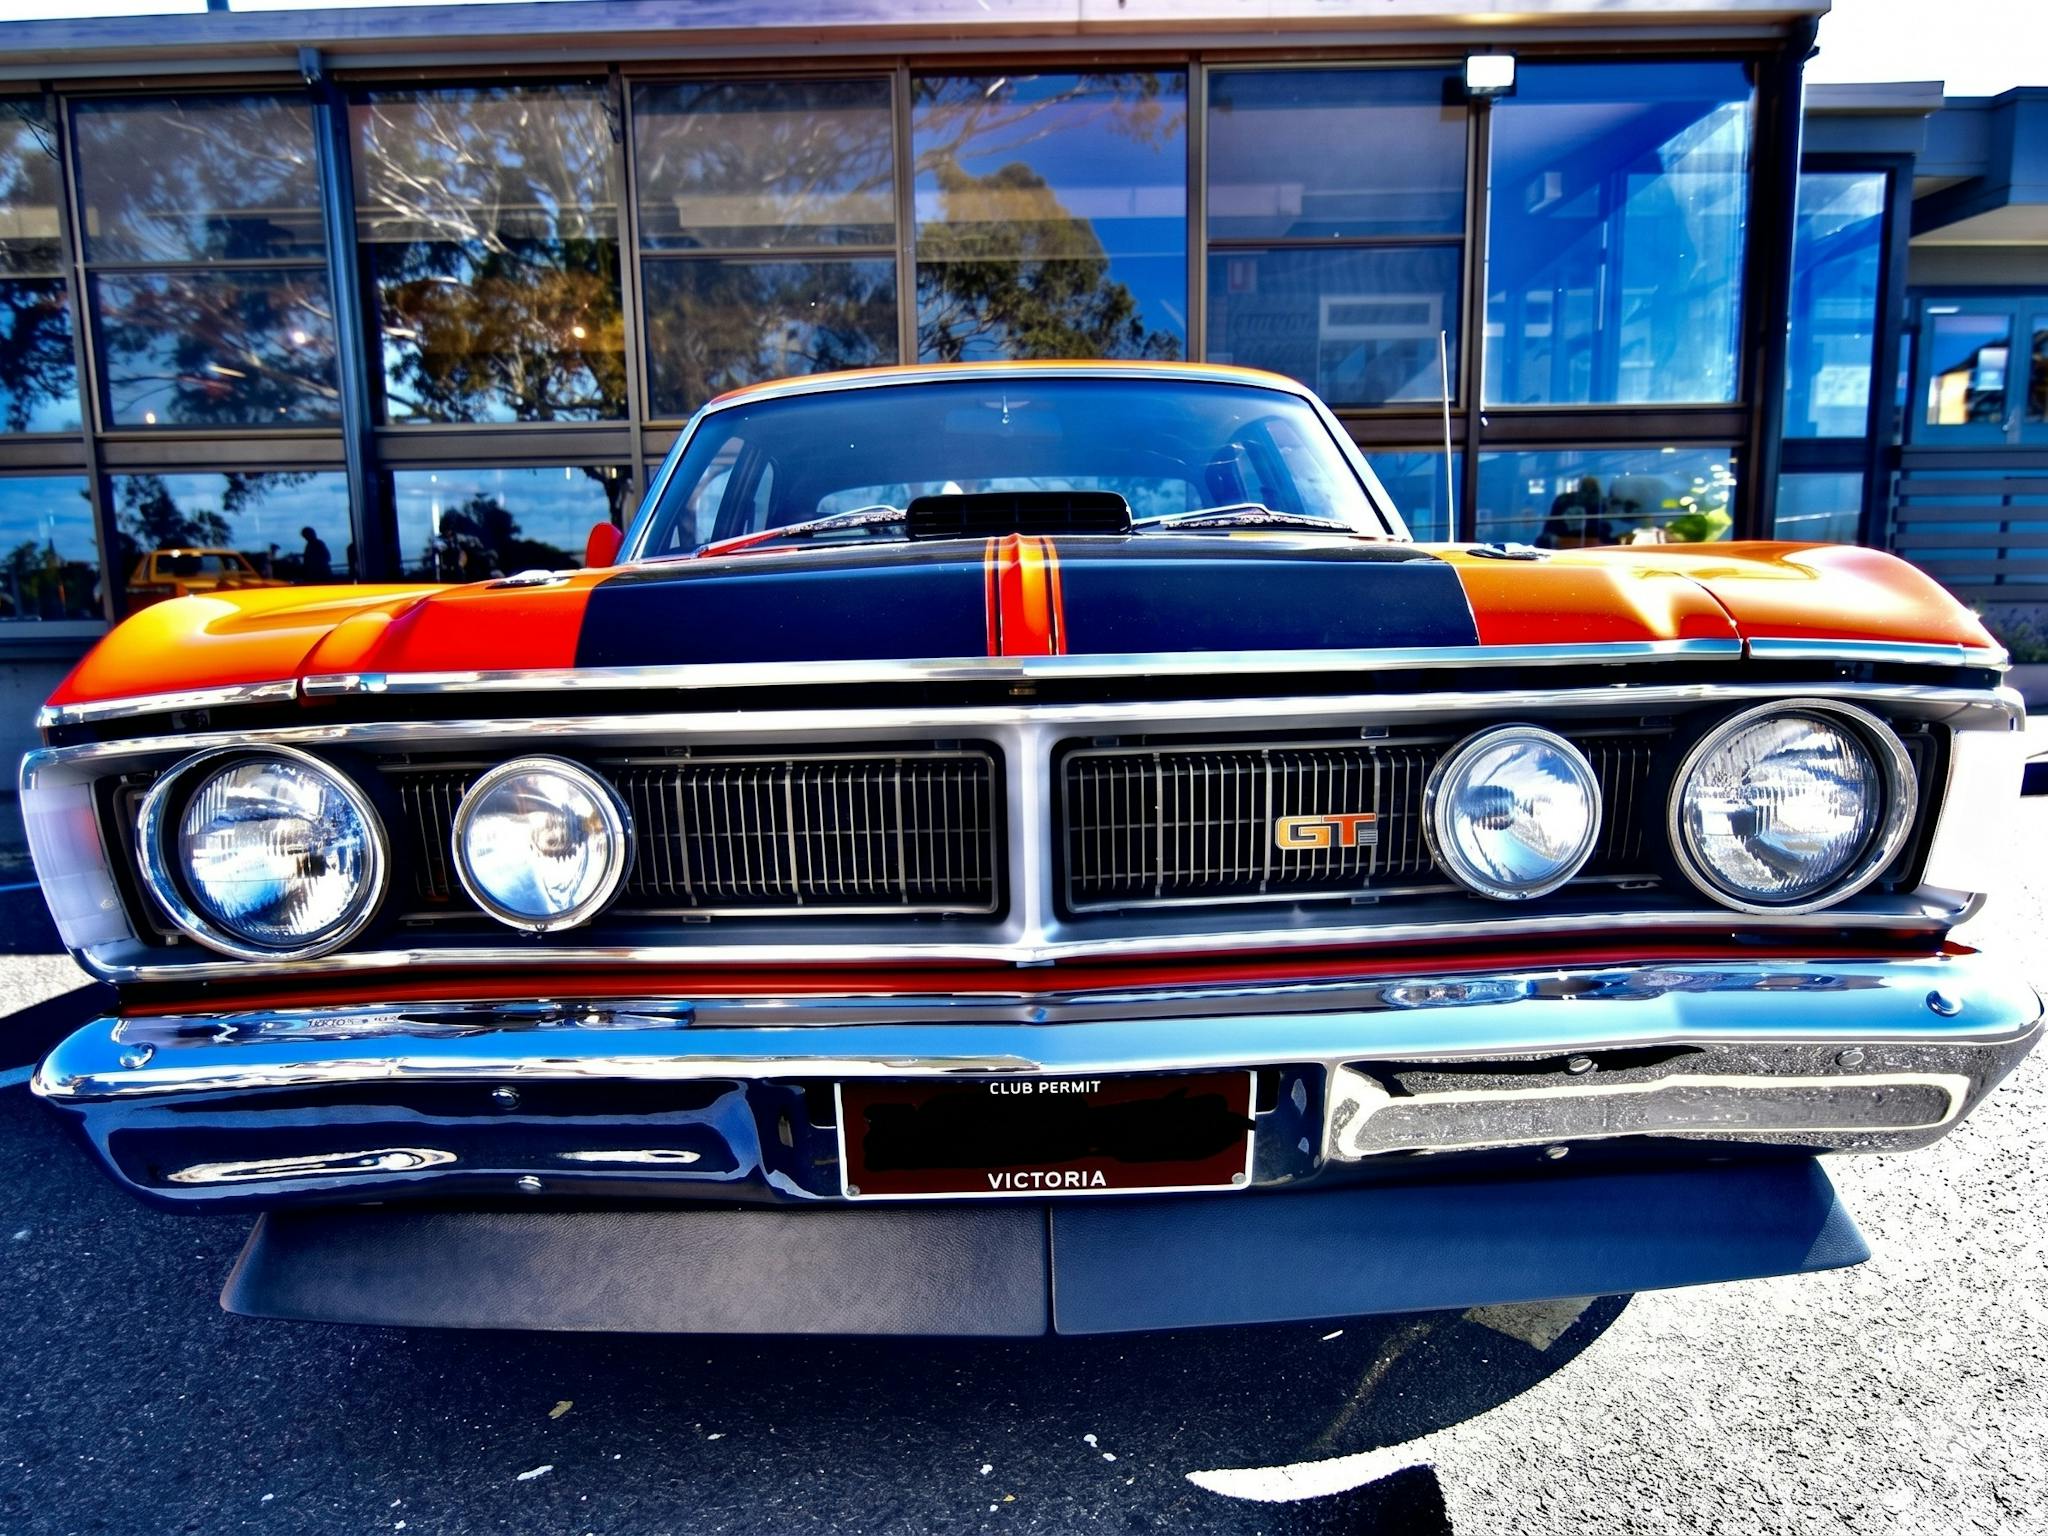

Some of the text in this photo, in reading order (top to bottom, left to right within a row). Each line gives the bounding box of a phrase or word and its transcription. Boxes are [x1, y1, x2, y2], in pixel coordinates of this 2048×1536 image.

[1275, 813, 1376, 849] GT
[990, 1081, 1101, 1094] CLUB PERMIT
[988, 1170, 1107, 1189] VICTORIA
